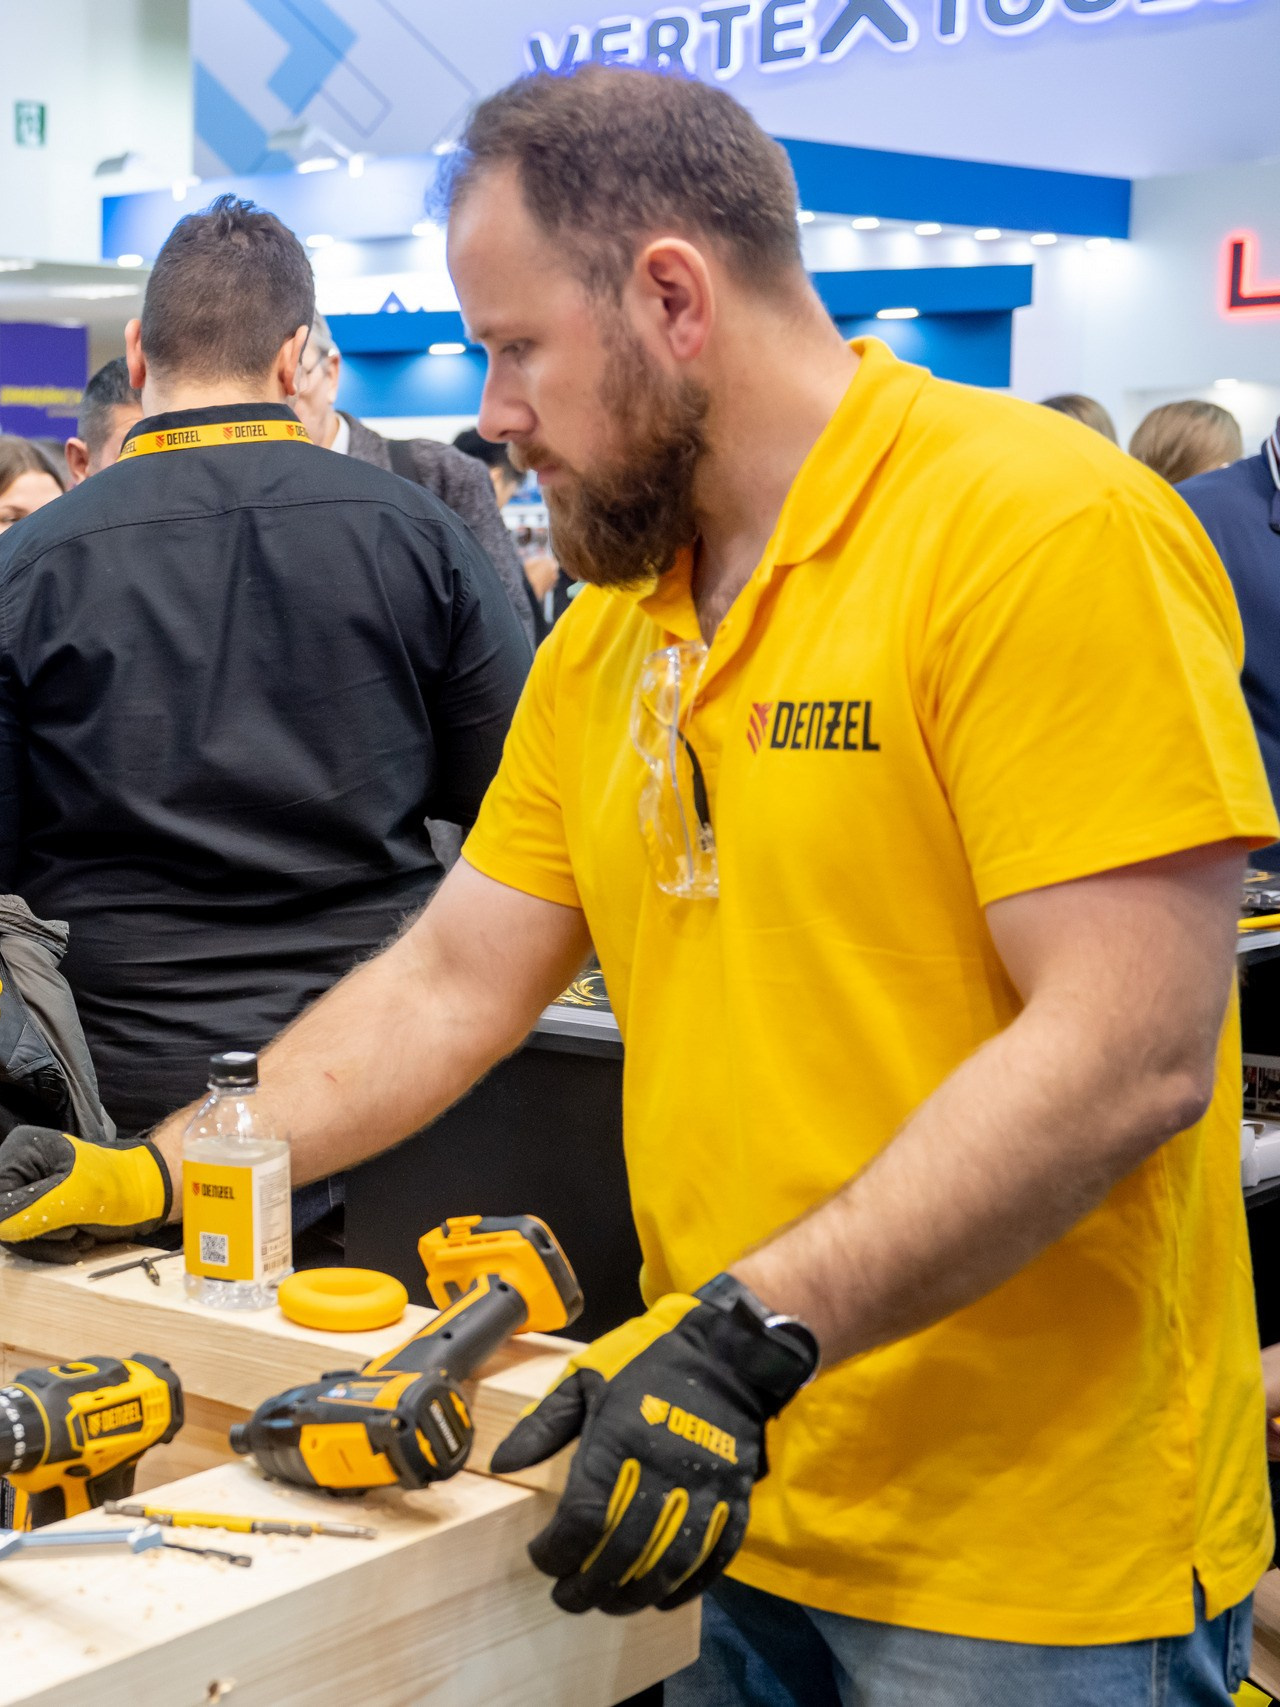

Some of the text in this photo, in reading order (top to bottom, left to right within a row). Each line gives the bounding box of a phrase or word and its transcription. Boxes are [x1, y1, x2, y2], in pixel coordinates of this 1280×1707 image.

[167, 430, 201, 446] DENZEL
[235, 425, 267, 438] DENZEL
[770, 701, 881, 752] DENZEL
[202, 1184, 235, 1199] DENZEL
[102, 1401, 142, 1432] DENZEL
[667, 1406, 738, 1465] DENZEL
